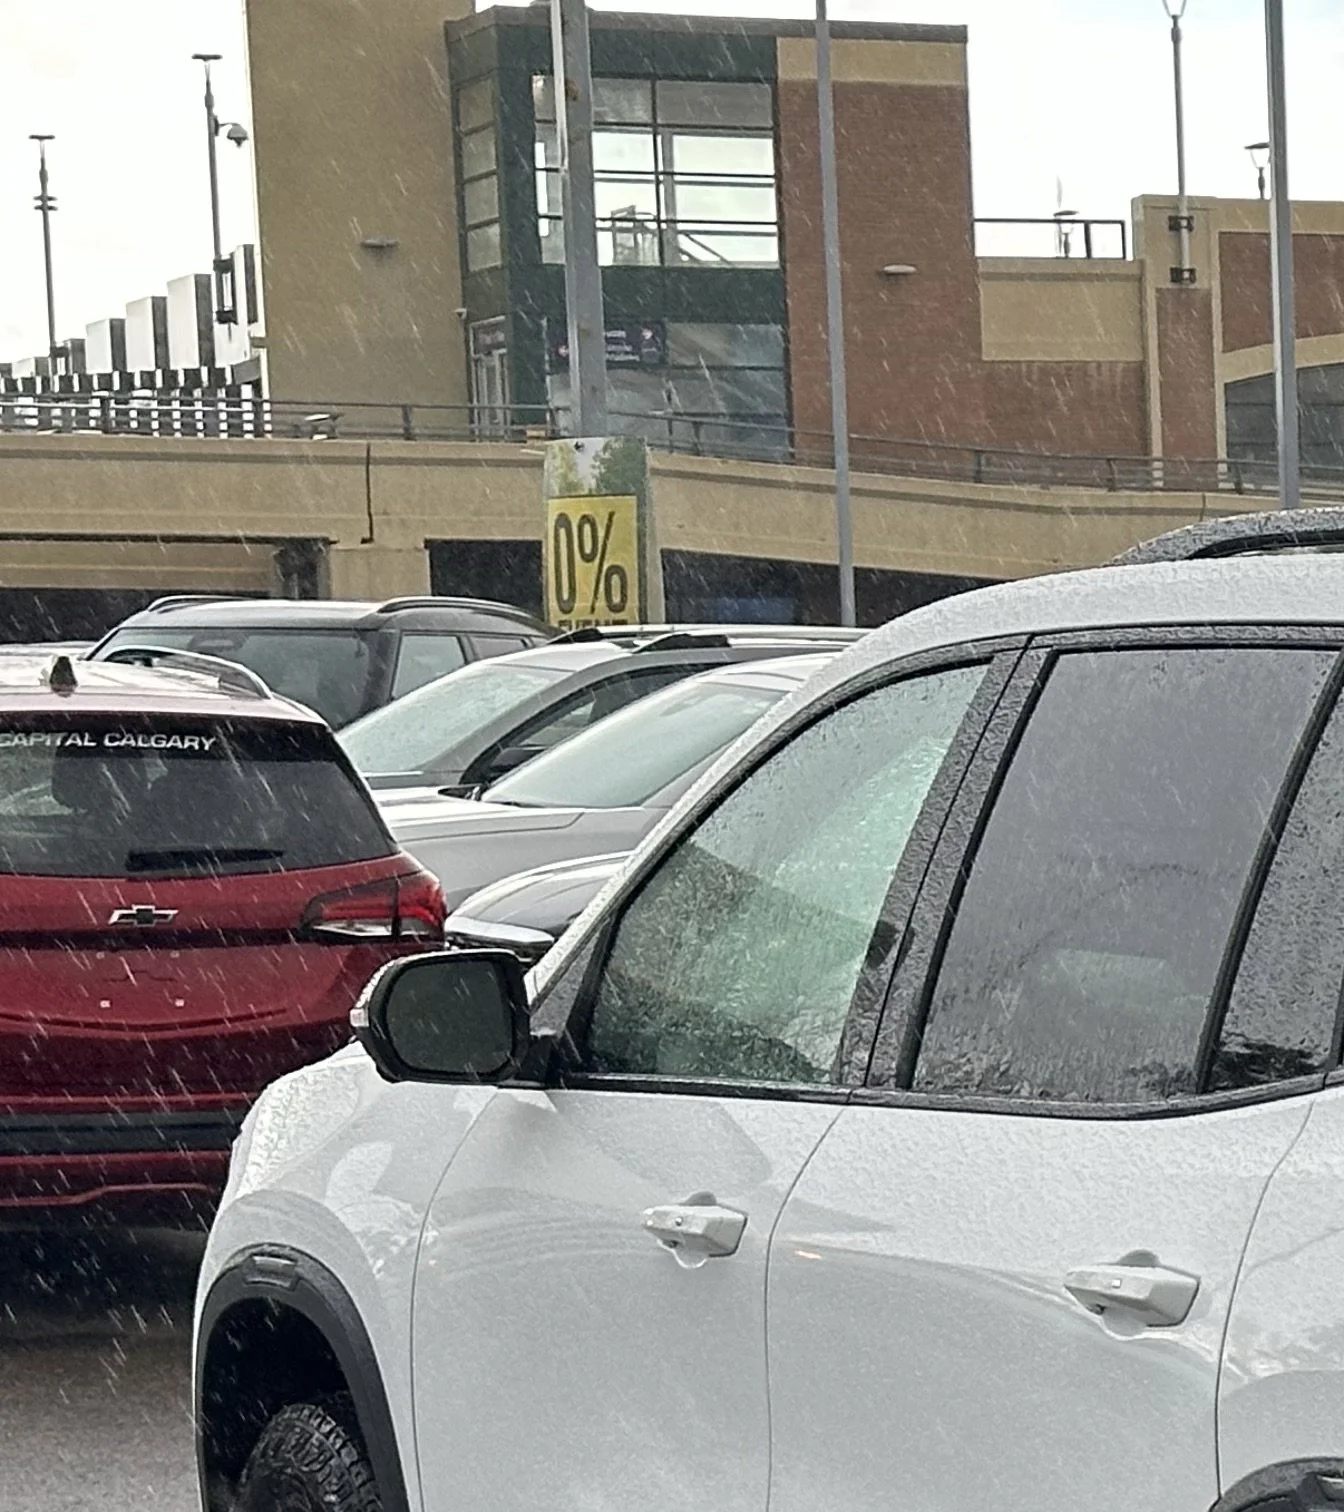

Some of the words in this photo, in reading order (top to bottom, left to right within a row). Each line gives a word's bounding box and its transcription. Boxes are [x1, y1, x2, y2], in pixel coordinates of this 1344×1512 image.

[553, 511, 628, 615] 0%
[0, 732, 97, 747] CAPITAL
[103, 732, 216, 751] CALGARY
